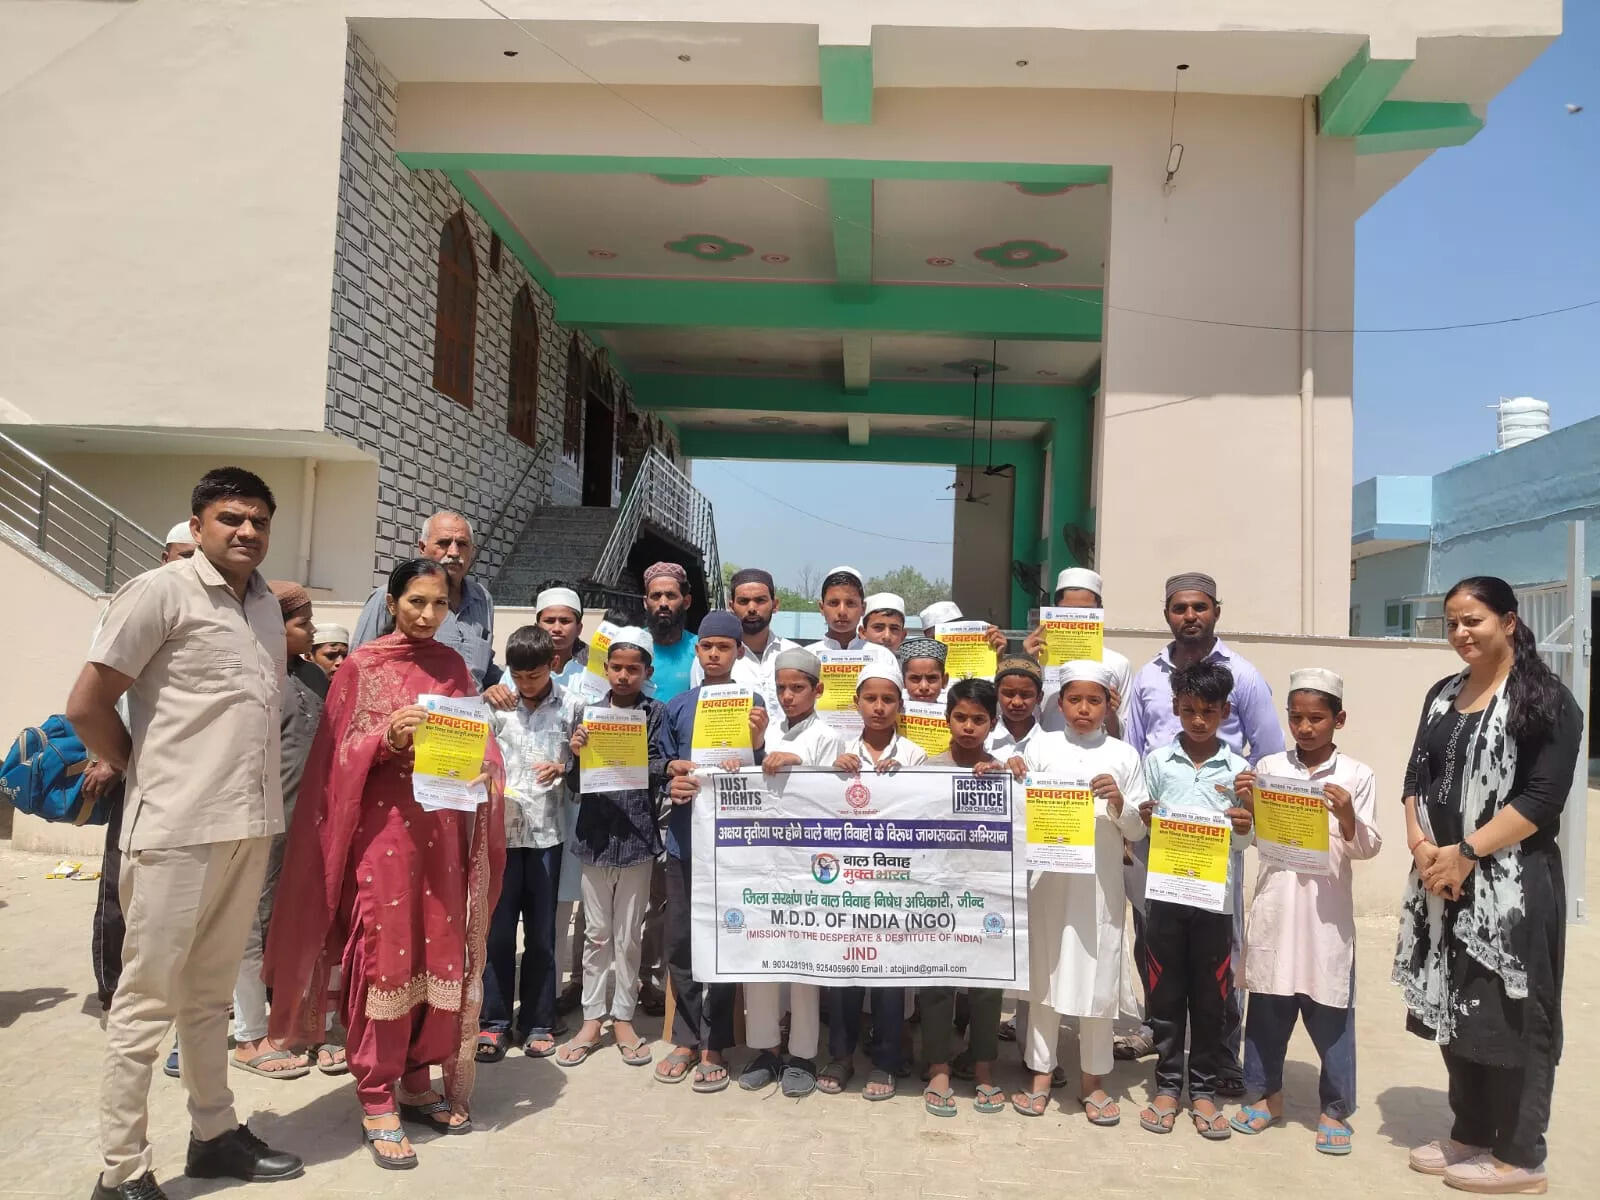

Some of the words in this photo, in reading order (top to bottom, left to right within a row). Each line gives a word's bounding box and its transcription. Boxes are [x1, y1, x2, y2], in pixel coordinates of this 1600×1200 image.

[822, 664, 866, 672] खबरदा
[702, 698, 749, 708] खबरदार!
[427, 712, 485, 733] खबरदार!
[900, 716, 949, 728] खबरदार
[720, 777, 748, 791] JUST
[720, 792, 762, 806] RIGHTS
[1026, 788, 1089, 800] खबरदार!
[1260, 790, 1323, 808] खबरदार!
[718, 826, 741, 840] अक्षय
[744, 822, 770, 844] तृतीया
[772, 827, 784, 840] पर
[804, 823, 822, 841] वाले
[823, 828, 841, 841] बाल
[874, 823, 884, 842] के
[968, 825, 1008, 844] अभियान
[1160, 819, 1225, 837] खबरदार!
[843, 855, 868, 867] बाल
[873, 853, 911, 868] विवाह
[843, 868, 874, 884] मुक्त
[875, 869, 911, 880] भारत
[743, 888, 769, 905] जिला
[820, 895, 840, 907] बाल
[842, 891, 871, 908] विवाह
[874, 891, 902, 908] निषेध
[957, 891, 984, 908] जीन्द
[771, 910, 820, 926] M.D.D.
[825, 913, 847, 928] OF
[852, 914, 899, 929] INDIA
[905, 913, 956, 932] (NGO)
[746, 930, 786, 940] (MISSION
[802, 931, 817, 940] THE
[820, 933, 872, 942] DESPERATE
[885, 933, 936, 942] DESTITUTE
[939, 934, 950, 942] OF
[954, 934, 982, 944] INDIA)
[843, 947, 877, 960] JIND
[816, 963, 859, 973] 9254059600
[890, 964, 967, 974] atojjind@gmail.com
